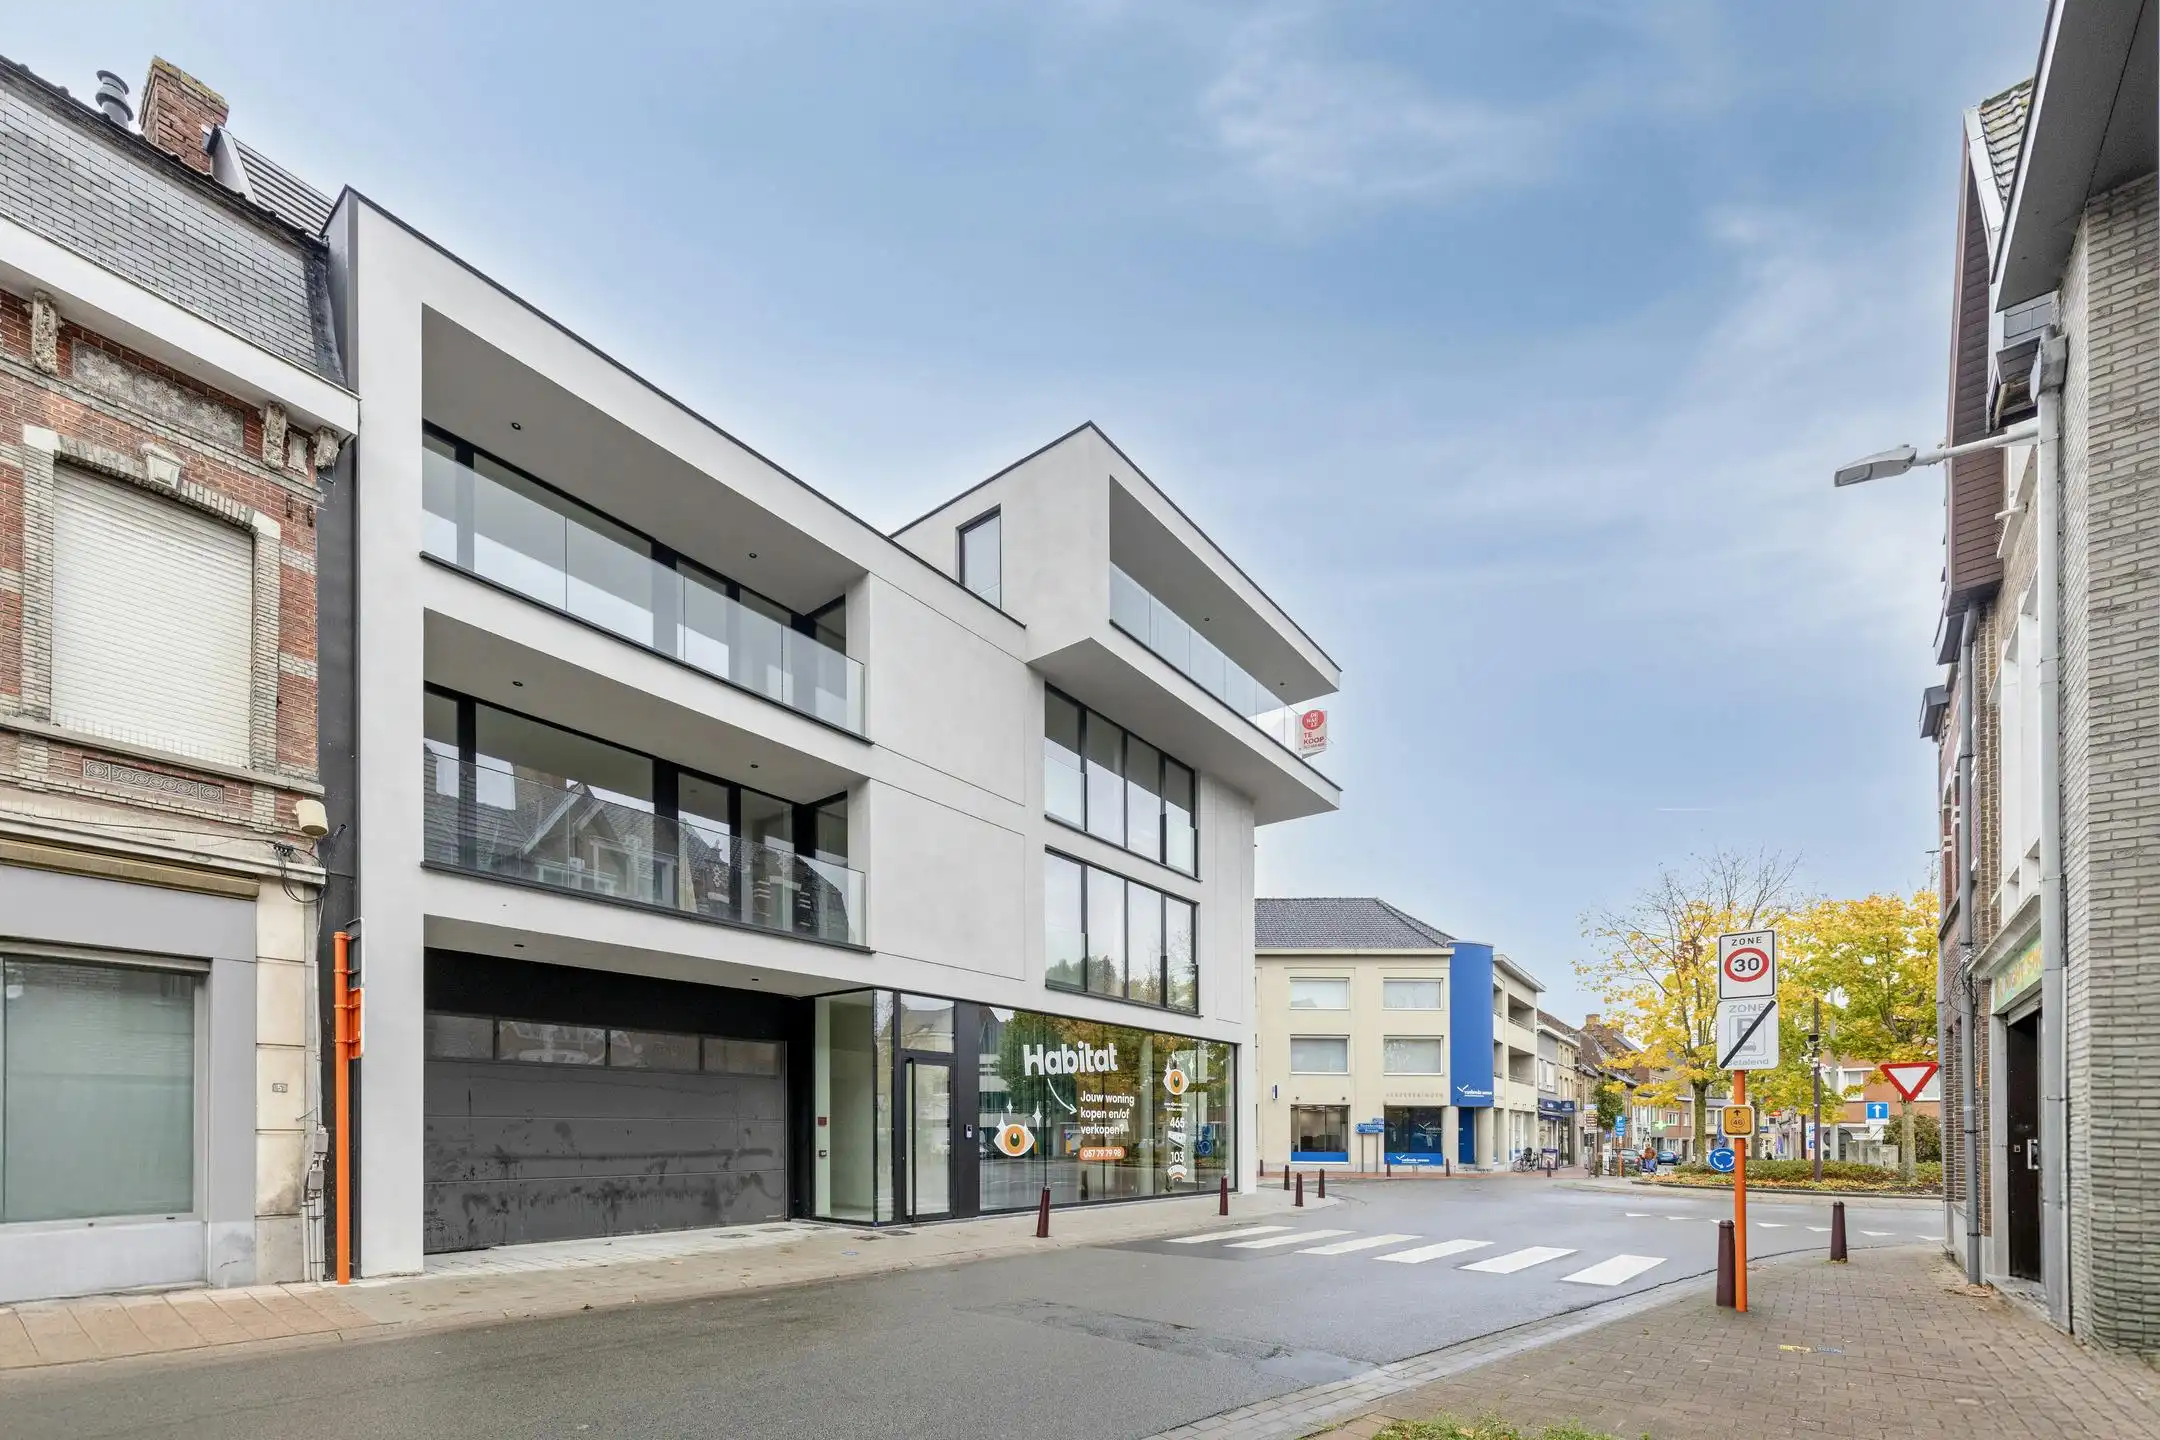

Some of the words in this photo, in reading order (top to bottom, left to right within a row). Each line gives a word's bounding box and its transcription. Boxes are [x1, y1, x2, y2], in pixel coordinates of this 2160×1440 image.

[1303, 736, 1325, 745] KOOP
[1731, 936, 1762, 946] ZONE
[1734, 957, 1760, 972] 30
[1729, 1003, 1765, 1013] ZONE
[1023, 1040, 1119, 1076] Habitat
[1080, 1090, 1104, 1103] Jouw
[1105, 1092, 1135, 1107] woning
[1080, 1106, 1107, 1121] kopen
[1108, 1108, 1130, 1119] en/of
[1080, 1123, 1125, 1137] verkopen?
[1170, 1151, 1185, 1163] 103
